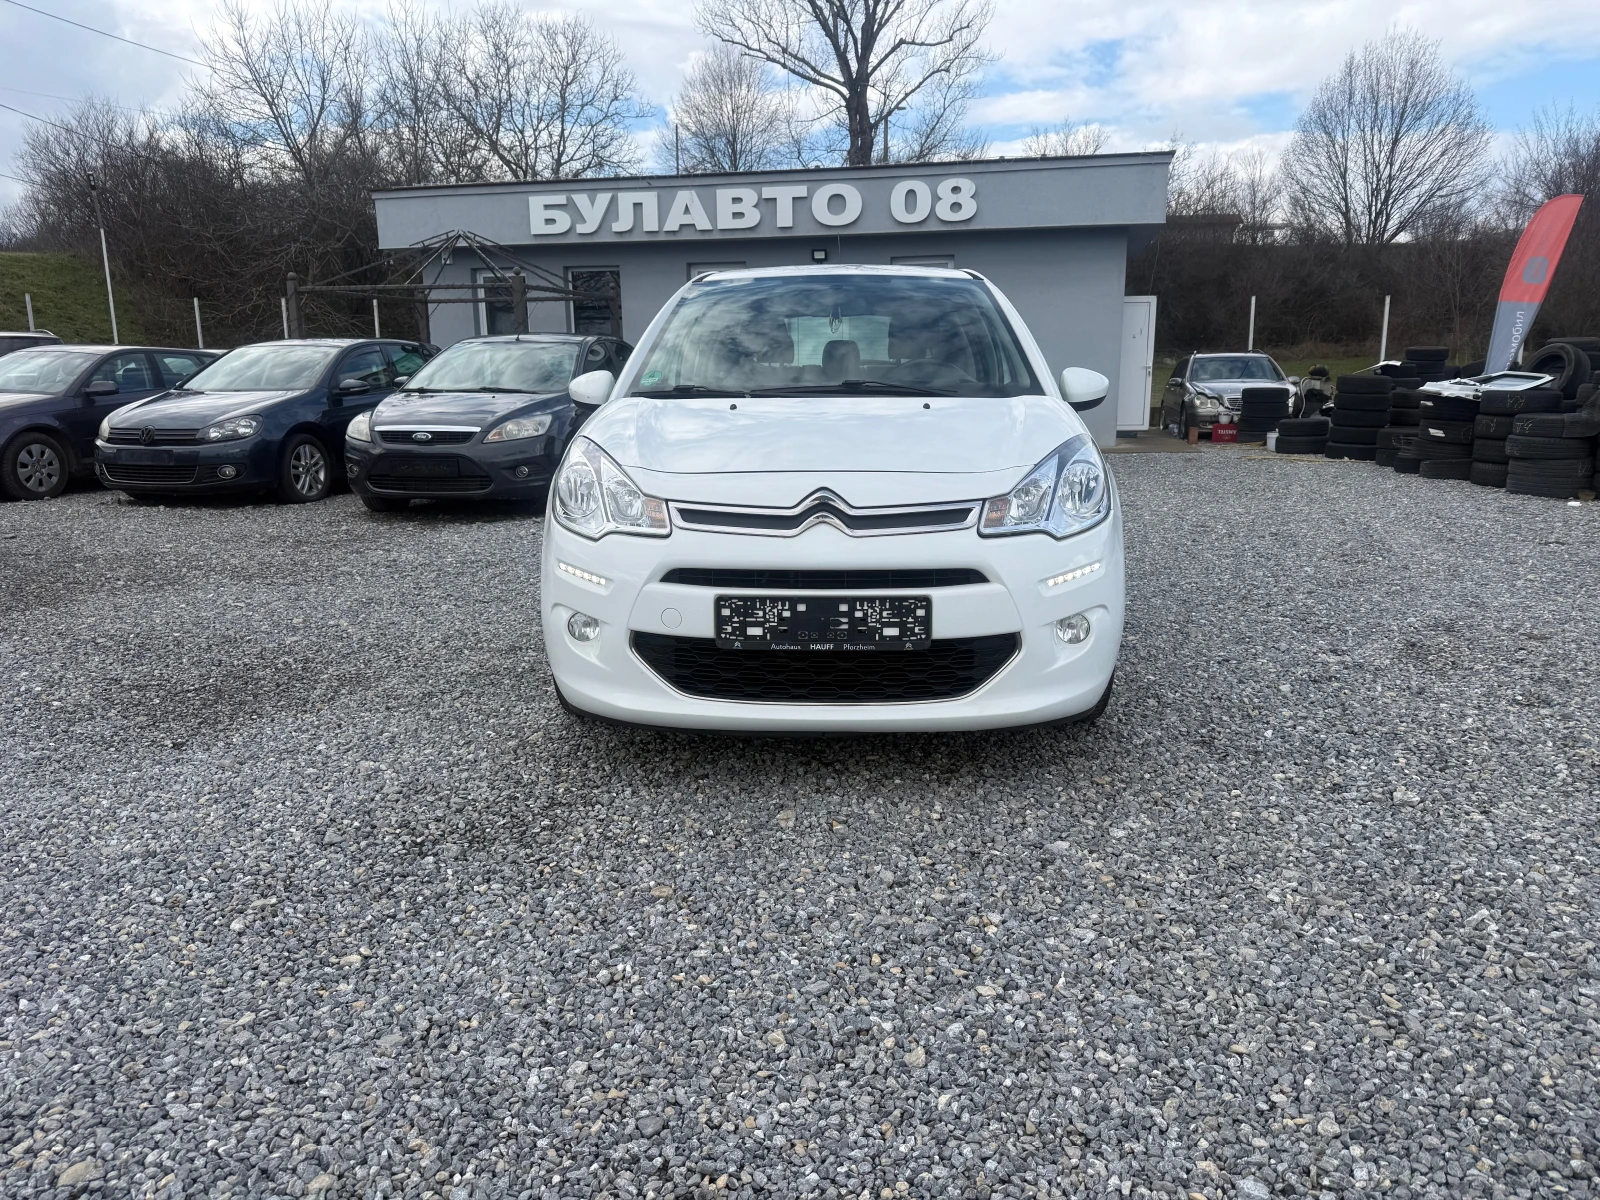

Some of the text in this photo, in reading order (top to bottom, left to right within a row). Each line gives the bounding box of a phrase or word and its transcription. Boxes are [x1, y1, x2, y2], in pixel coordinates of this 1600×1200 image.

[528, 178, 978, 235] БУЛАВТО 08
[843, 643, 876, 651] Pforzheim
